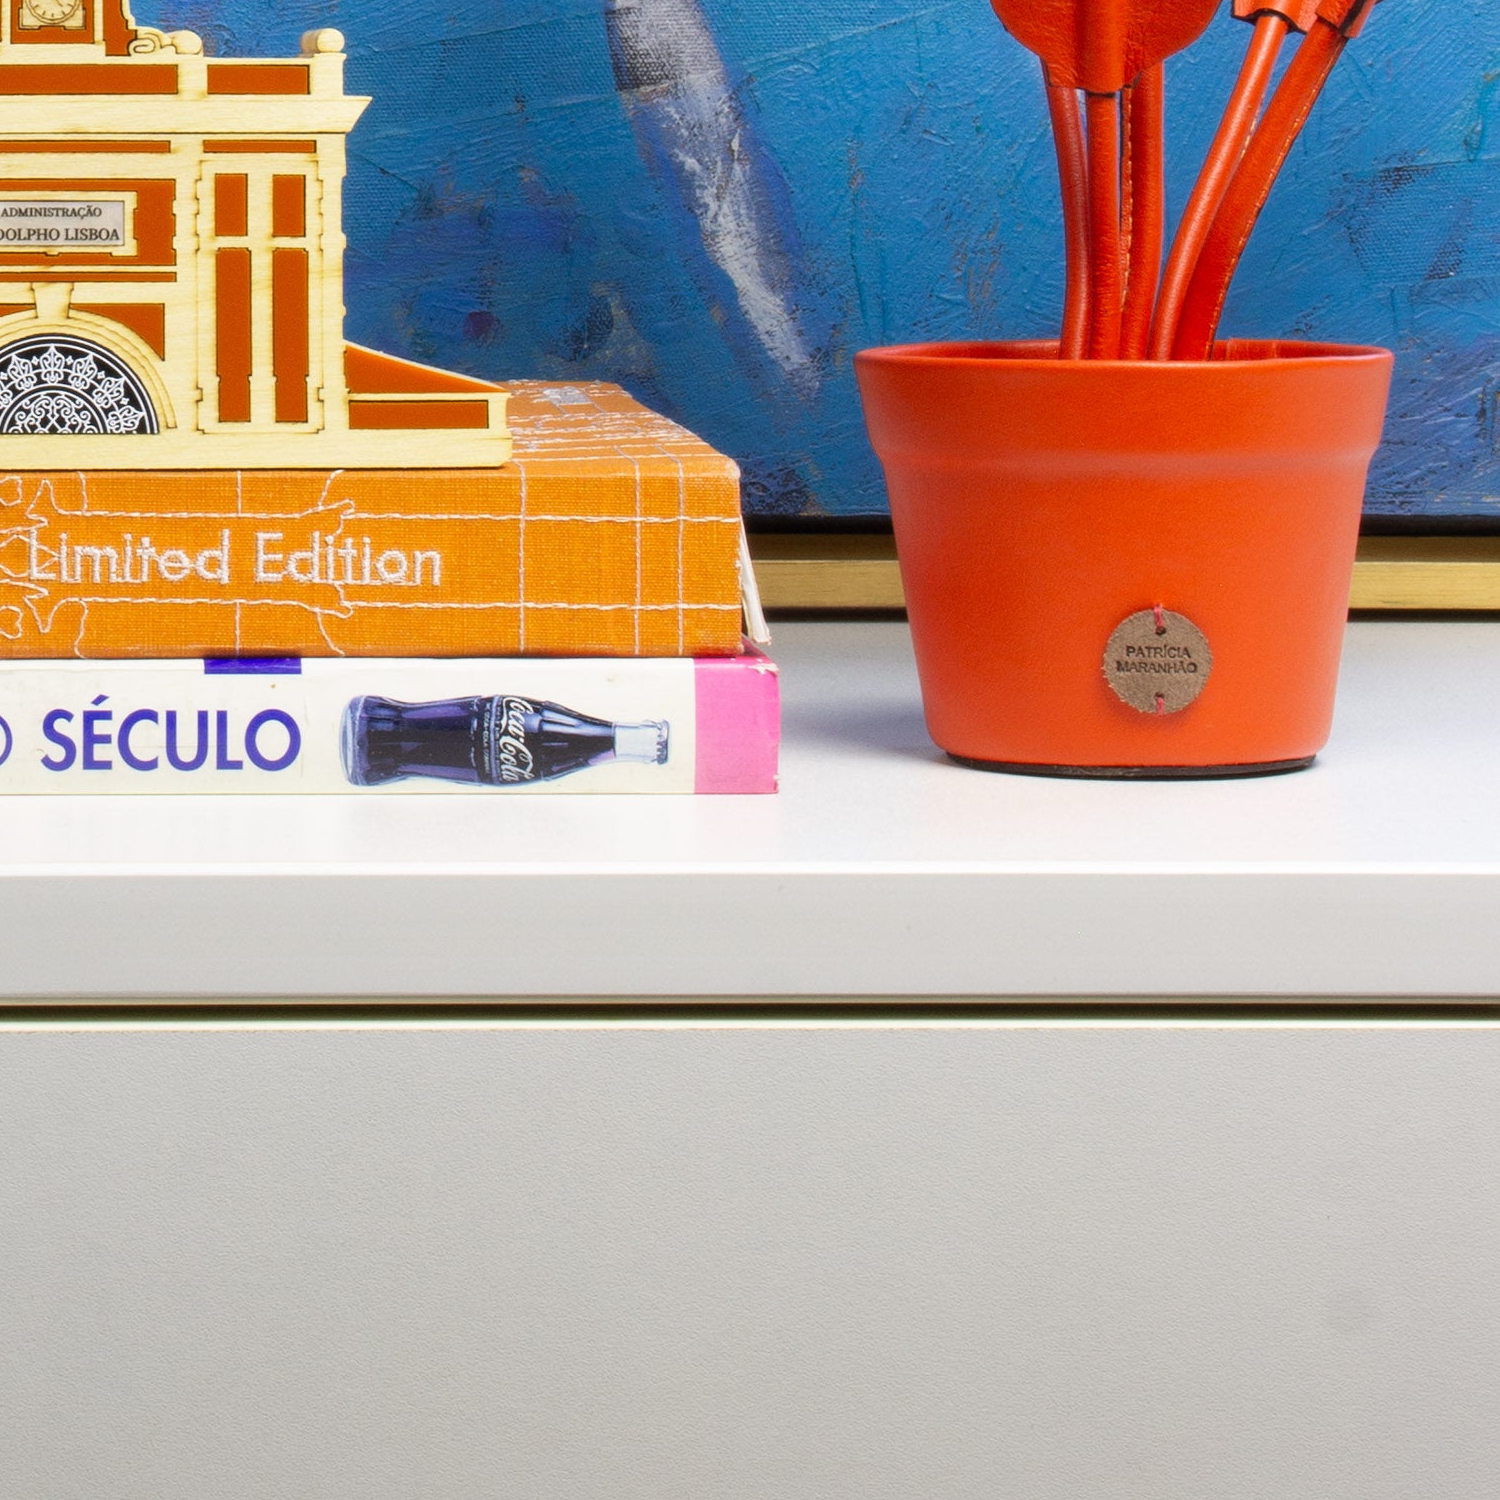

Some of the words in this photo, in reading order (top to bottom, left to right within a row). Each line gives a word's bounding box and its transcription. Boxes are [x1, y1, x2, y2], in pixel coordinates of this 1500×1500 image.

[1, 205, 102, 220] ADMINISTRAÇÃO
[65, 228, 120, 241] LISBOA
[28, 528, 230, 584] Limited
[255, 530, 441, 586] Edition
[1126, 644, 1191, 659] PATRÍCIA
[1117, 660, 1198, 673] MARANHÃO
[41, 694, 301, 772] SÉCULO
